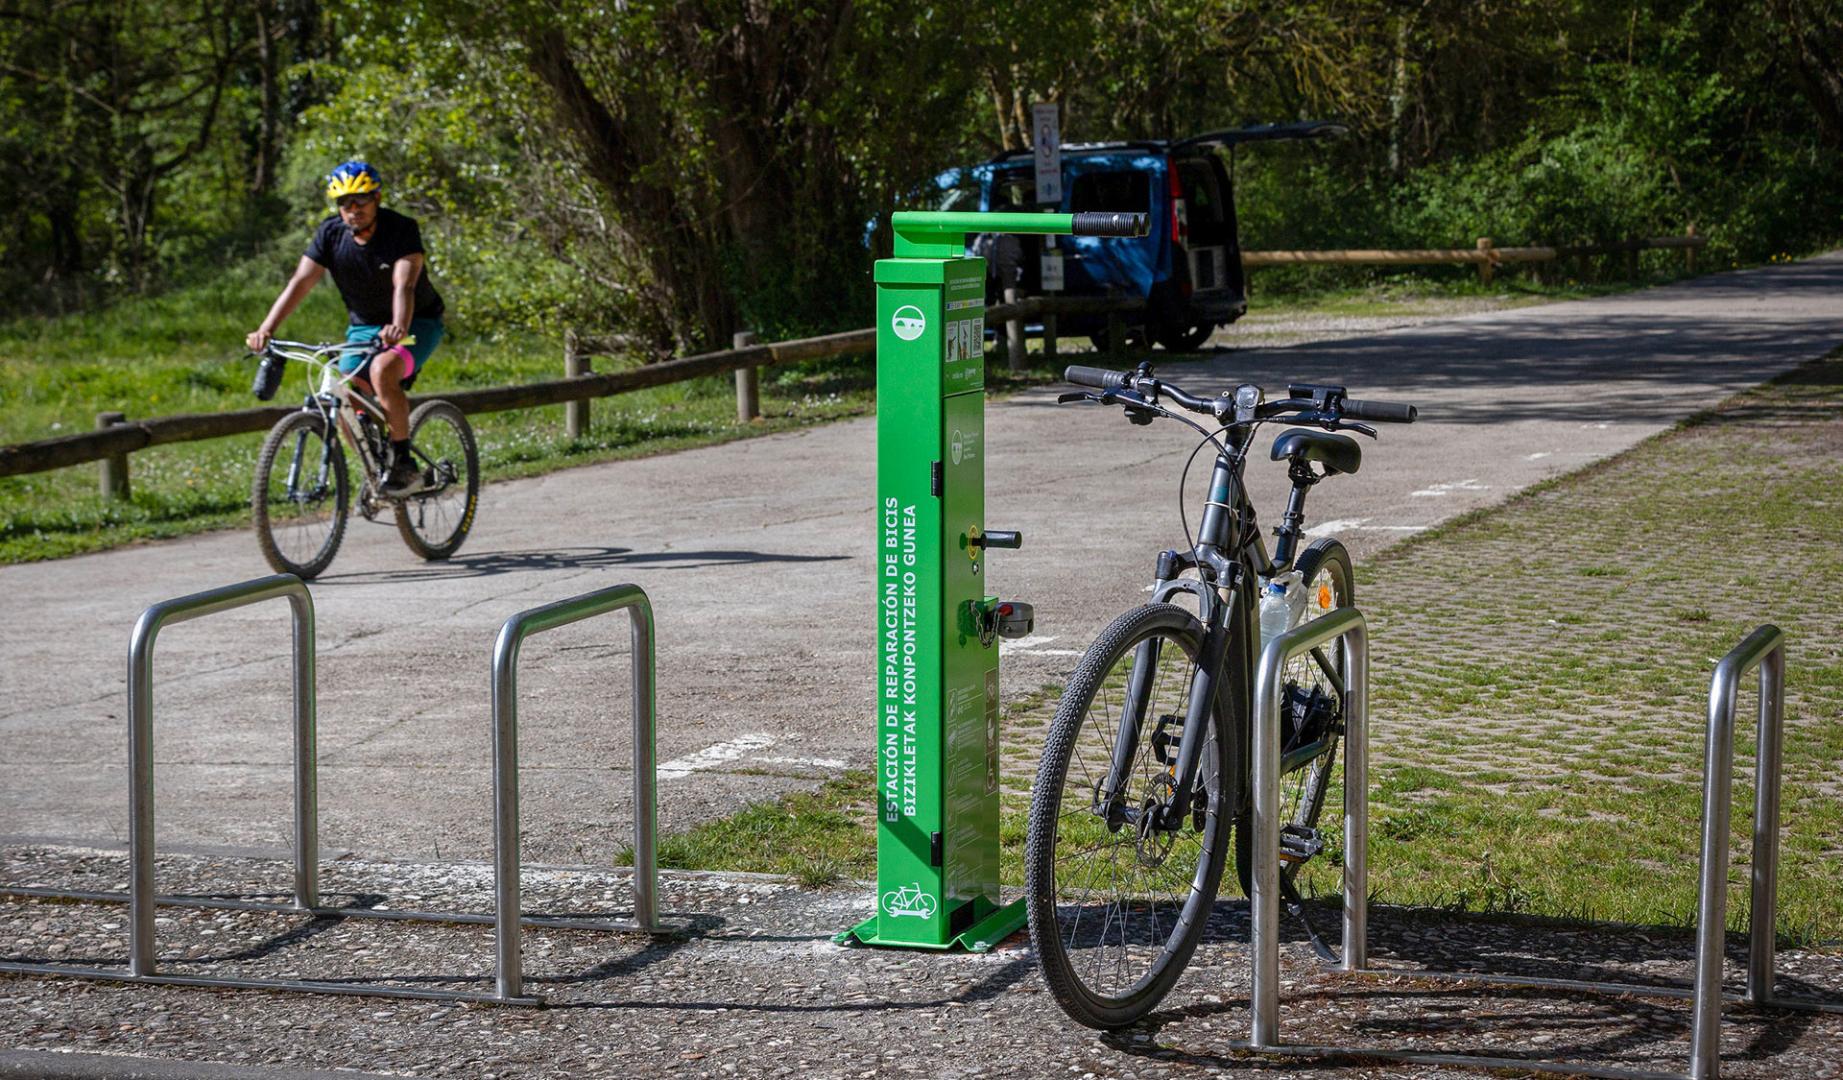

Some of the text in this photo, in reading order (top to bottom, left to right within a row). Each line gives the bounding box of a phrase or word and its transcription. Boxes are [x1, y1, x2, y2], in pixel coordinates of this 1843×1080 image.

[883, 497, 899, 822] ESTACIÓN DE REPARACIÓN DE BICIS
[902, 505, 917, 817] BIZIKLETAK KONPONTZEKO GUNEA
